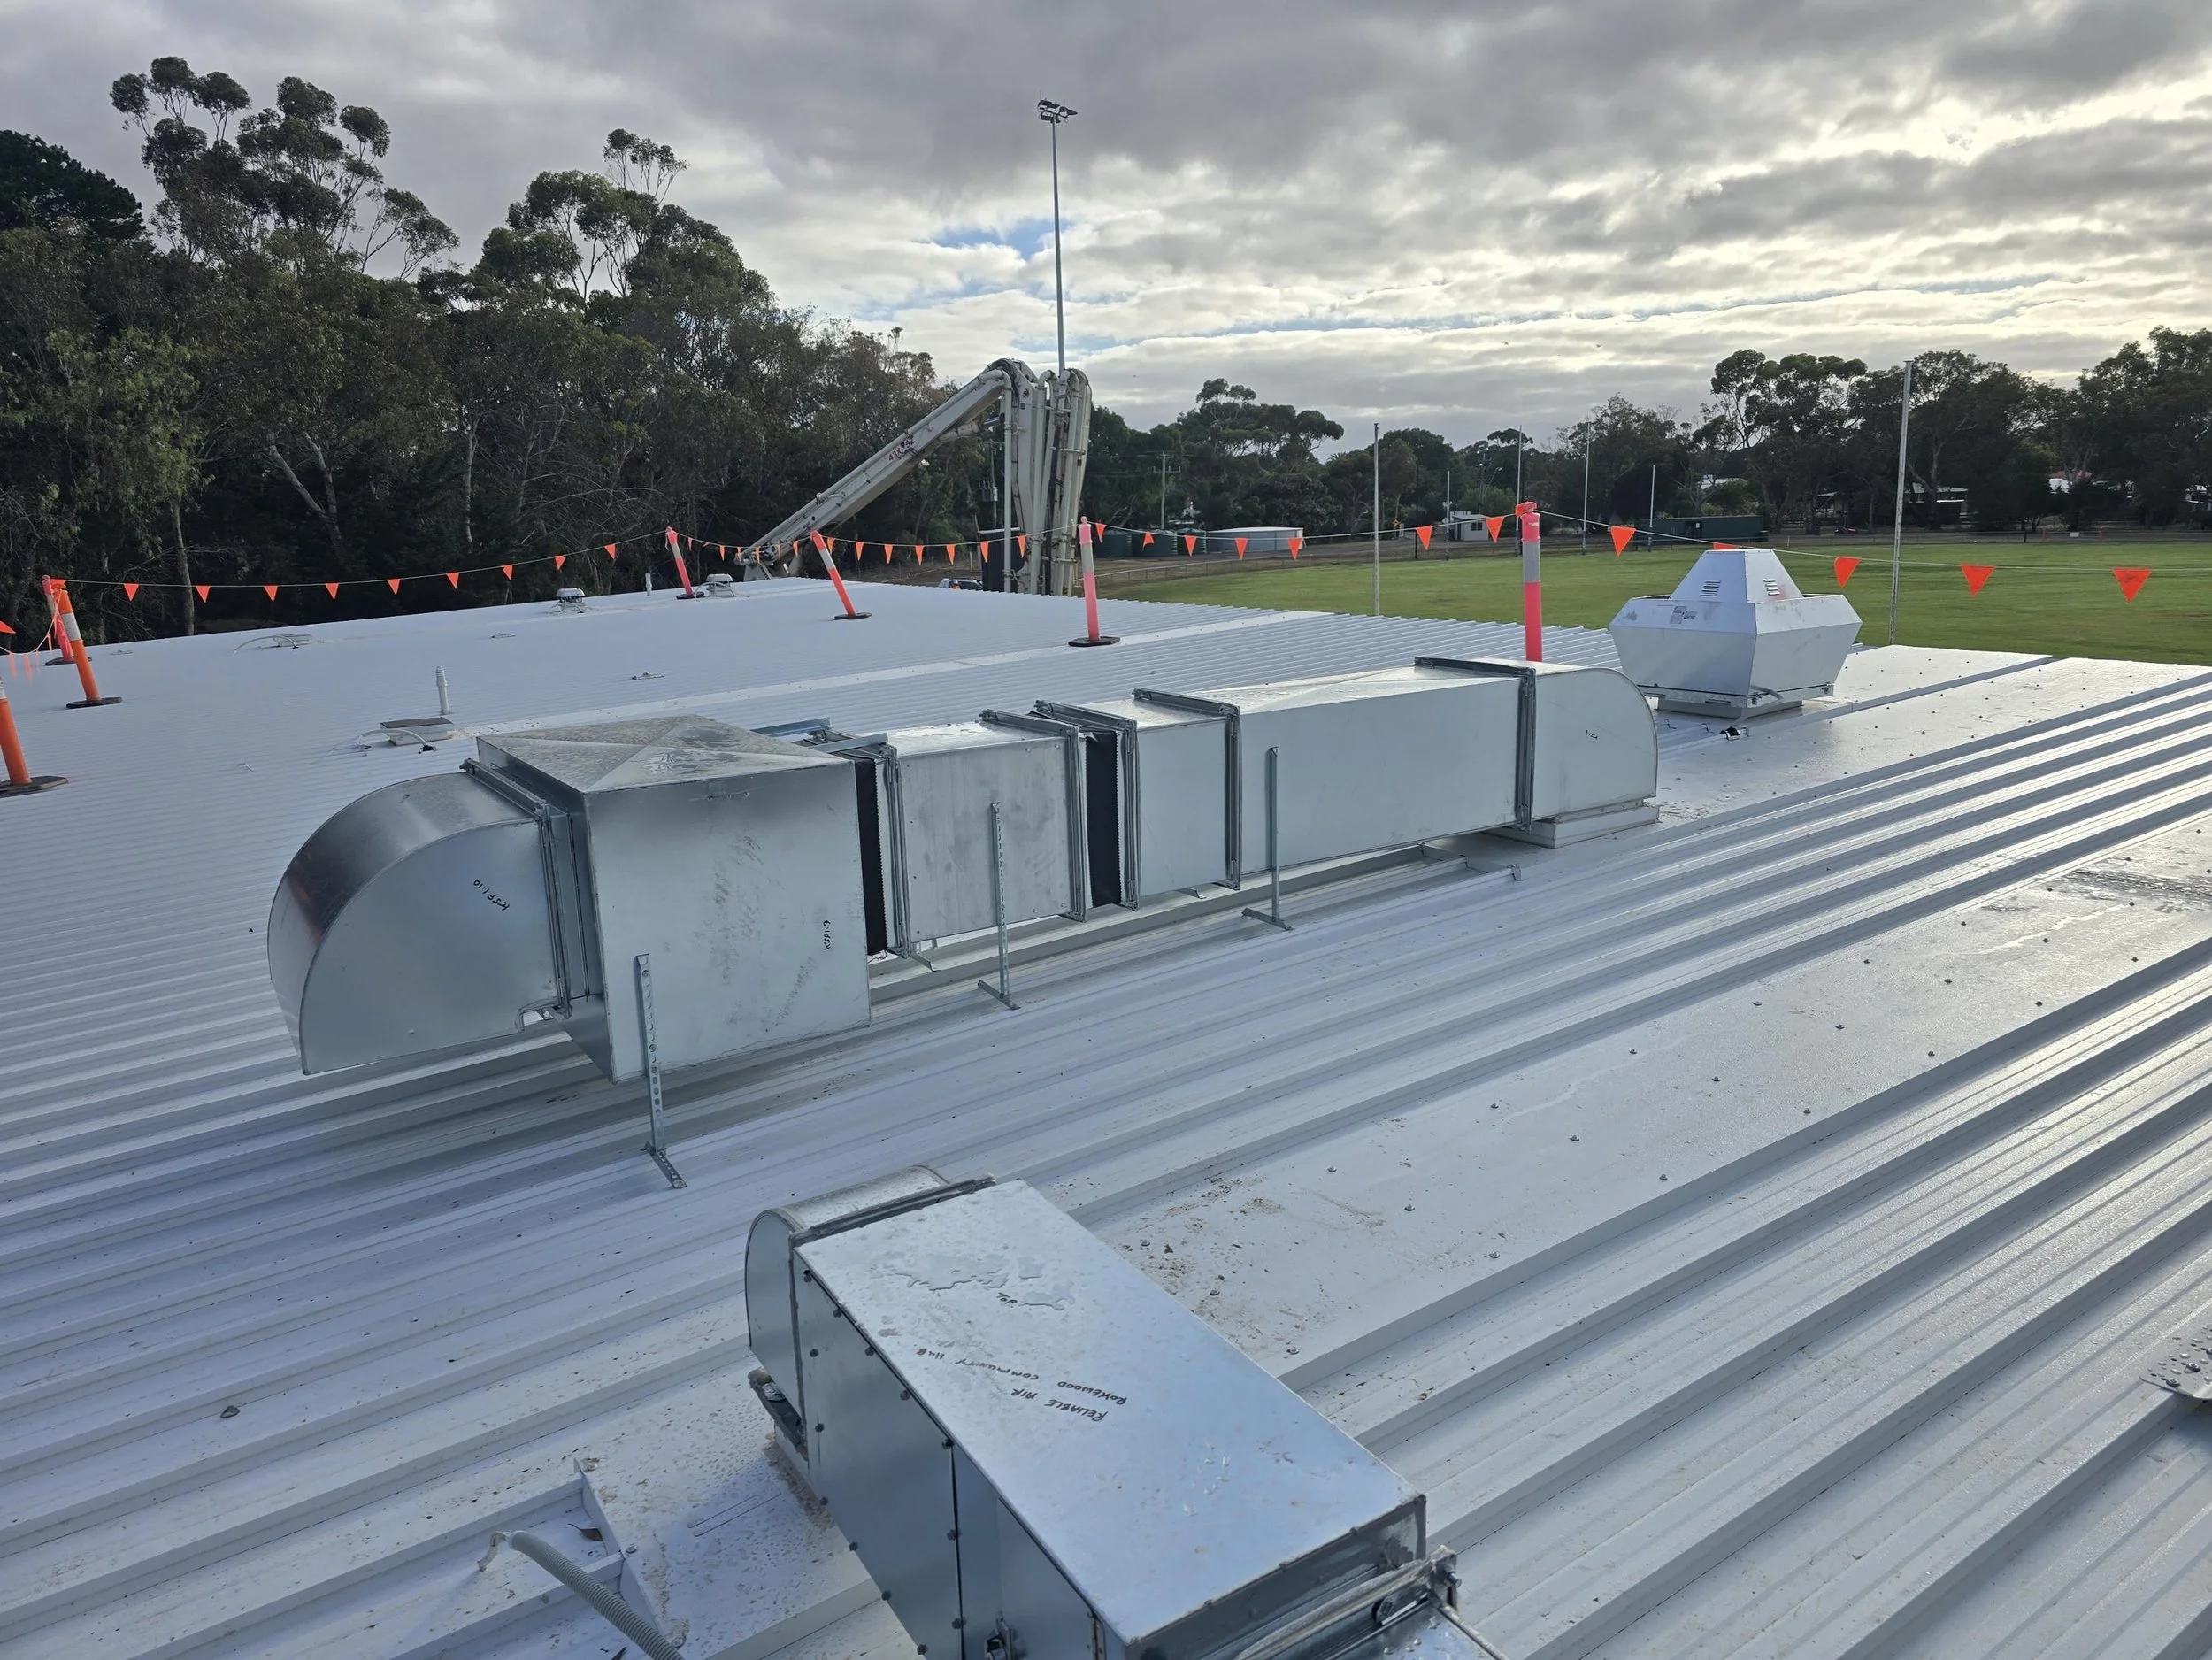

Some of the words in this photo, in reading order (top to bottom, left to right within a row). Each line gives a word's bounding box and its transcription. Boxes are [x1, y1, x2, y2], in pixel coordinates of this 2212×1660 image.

[955, 1358, 1040, 1380] COMMUNITY
[1010, 1388, 1038, 1399] AIR
[1057, 1381, 1127, 1405] ROKEWOOD
[1044, 1399, 1108, 1422] RELIABLE
